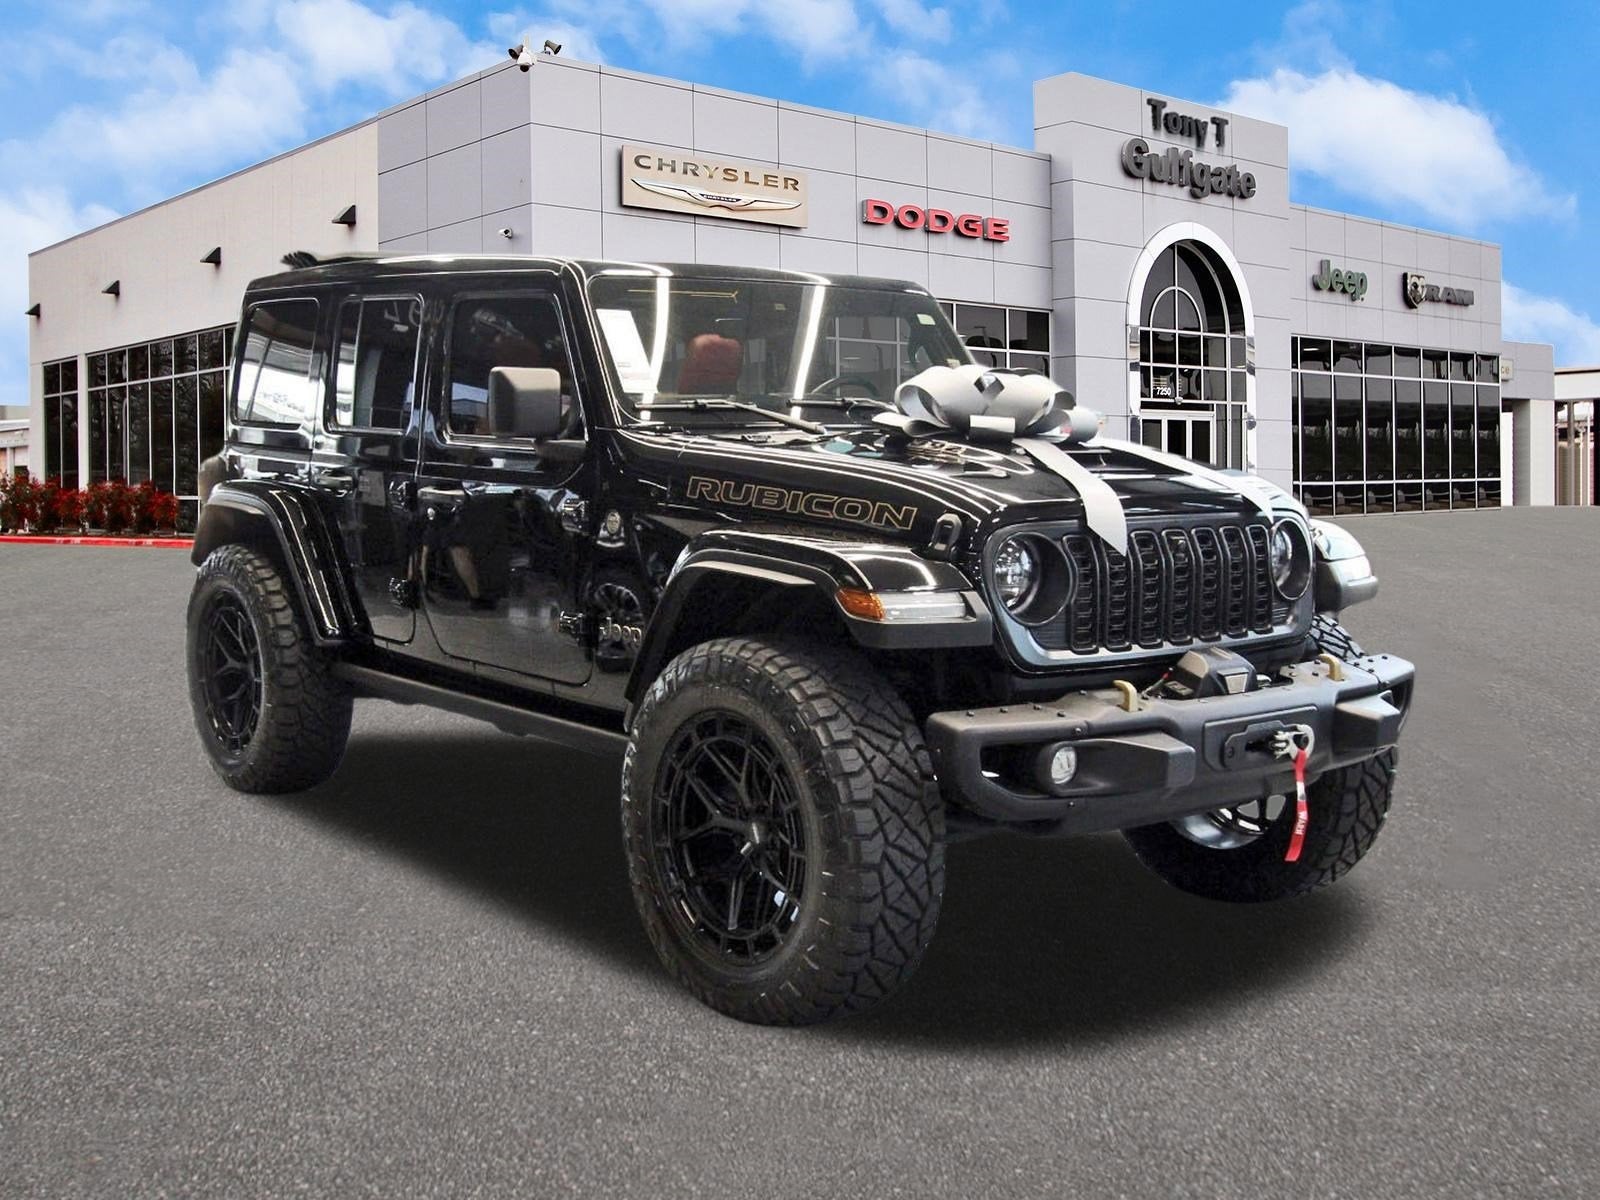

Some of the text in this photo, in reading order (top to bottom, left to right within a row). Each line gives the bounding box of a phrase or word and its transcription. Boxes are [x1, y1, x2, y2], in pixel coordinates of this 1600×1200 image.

[1146, 98, 1229, 148] Tony T
[633, 154, 800, 192] CHRYSLER
[1121, 138, 1256, 198] Gulfgate
[862, 199, 1010, 242] DODGE
[1312, 259, 1368, 302] Jeep
[1424, 284, 1475, 307] RAM
[1156, 386, 1172, 396] 7250
[686, 476, 918, 530] RUBICON
